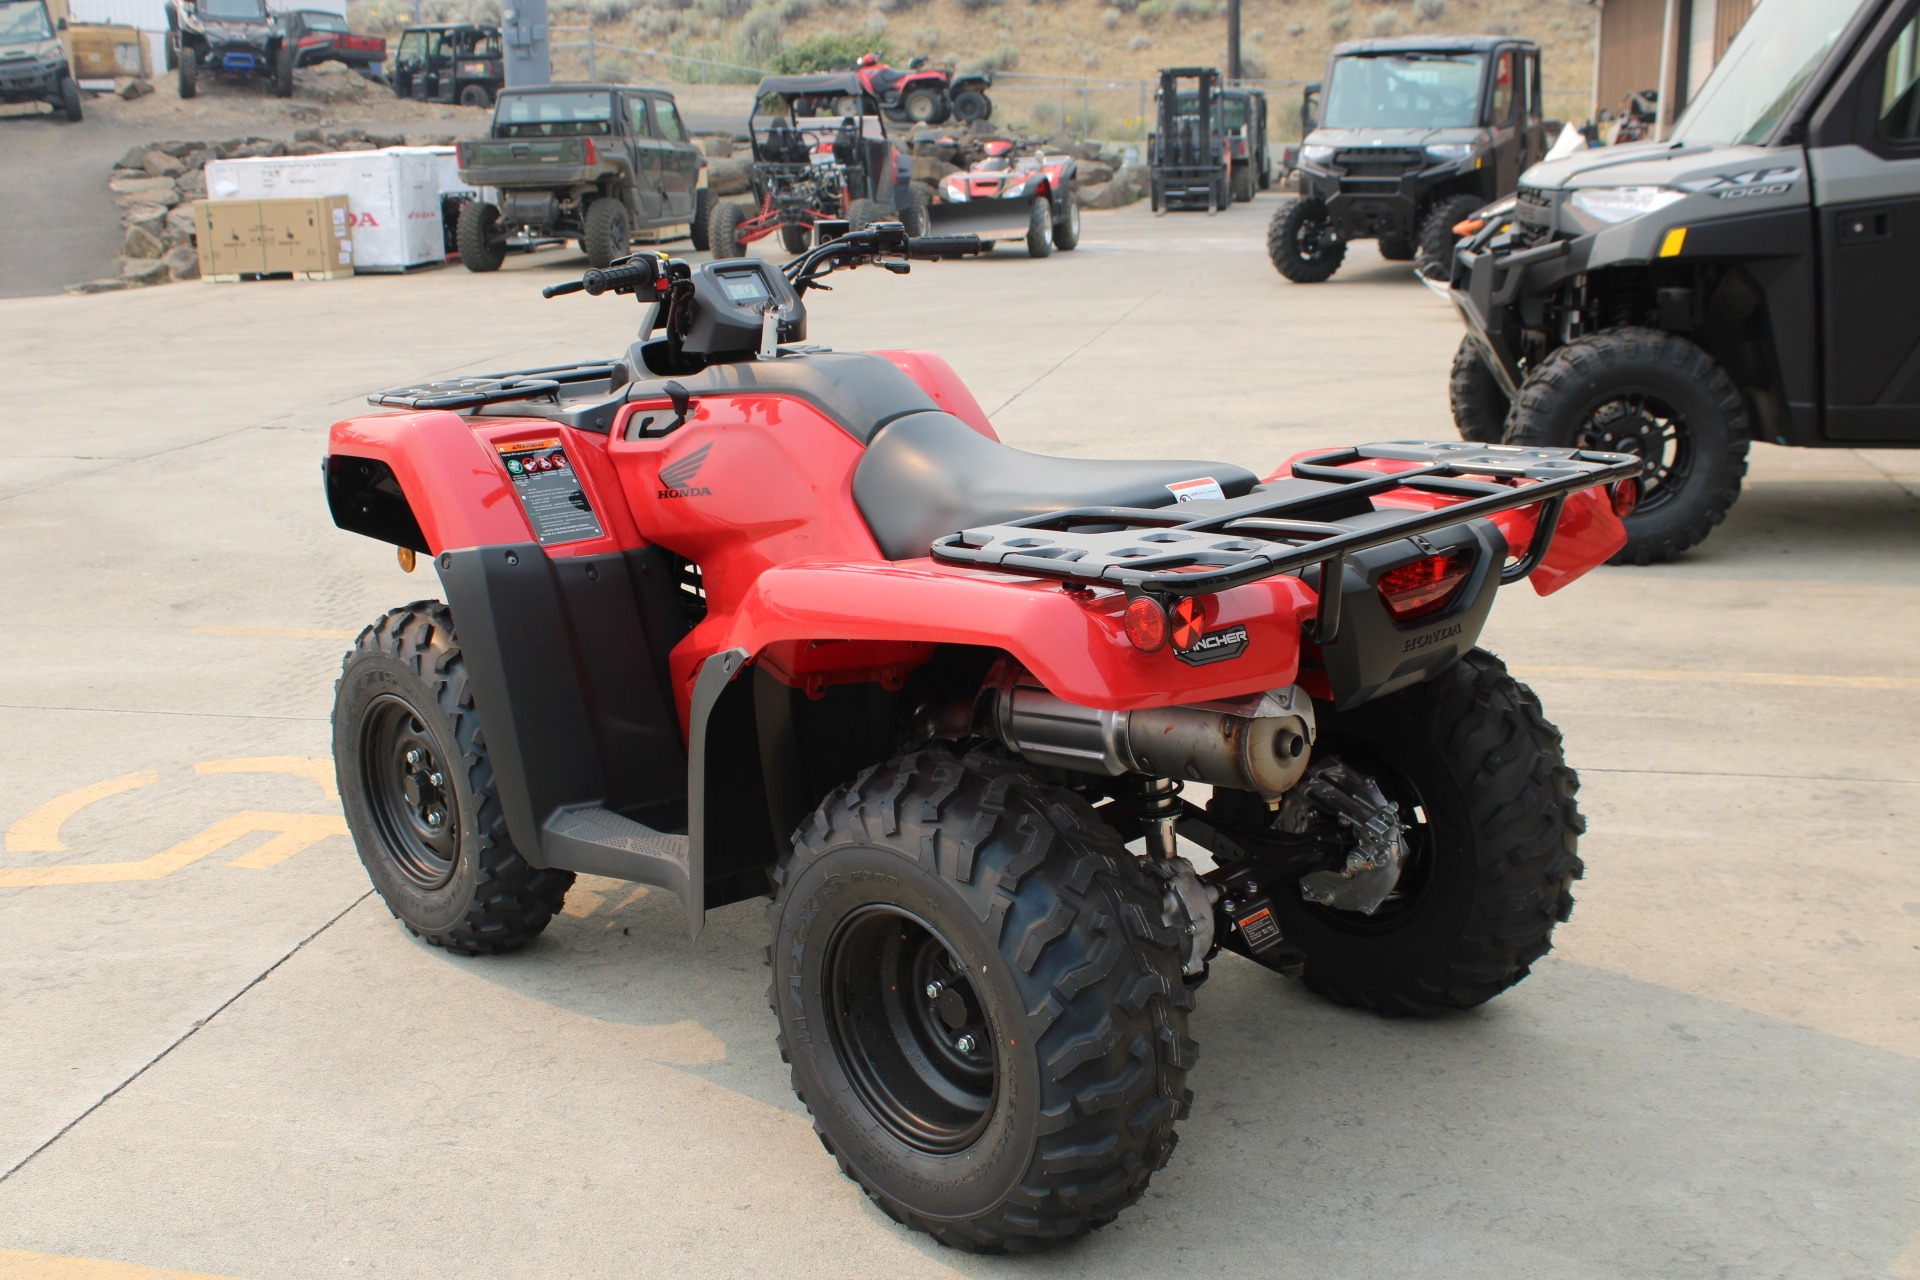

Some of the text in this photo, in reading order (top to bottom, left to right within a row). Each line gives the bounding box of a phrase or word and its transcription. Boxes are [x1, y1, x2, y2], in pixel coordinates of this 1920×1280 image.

[1705, 165, 1796, 188] XP
[1720, 183, 1791, 200] 1000
[657, 486, 713, 499] HONDA
[1402, 622, 1462, 653] HONDA
[788, 873, 845, 1058] MAXXIS
